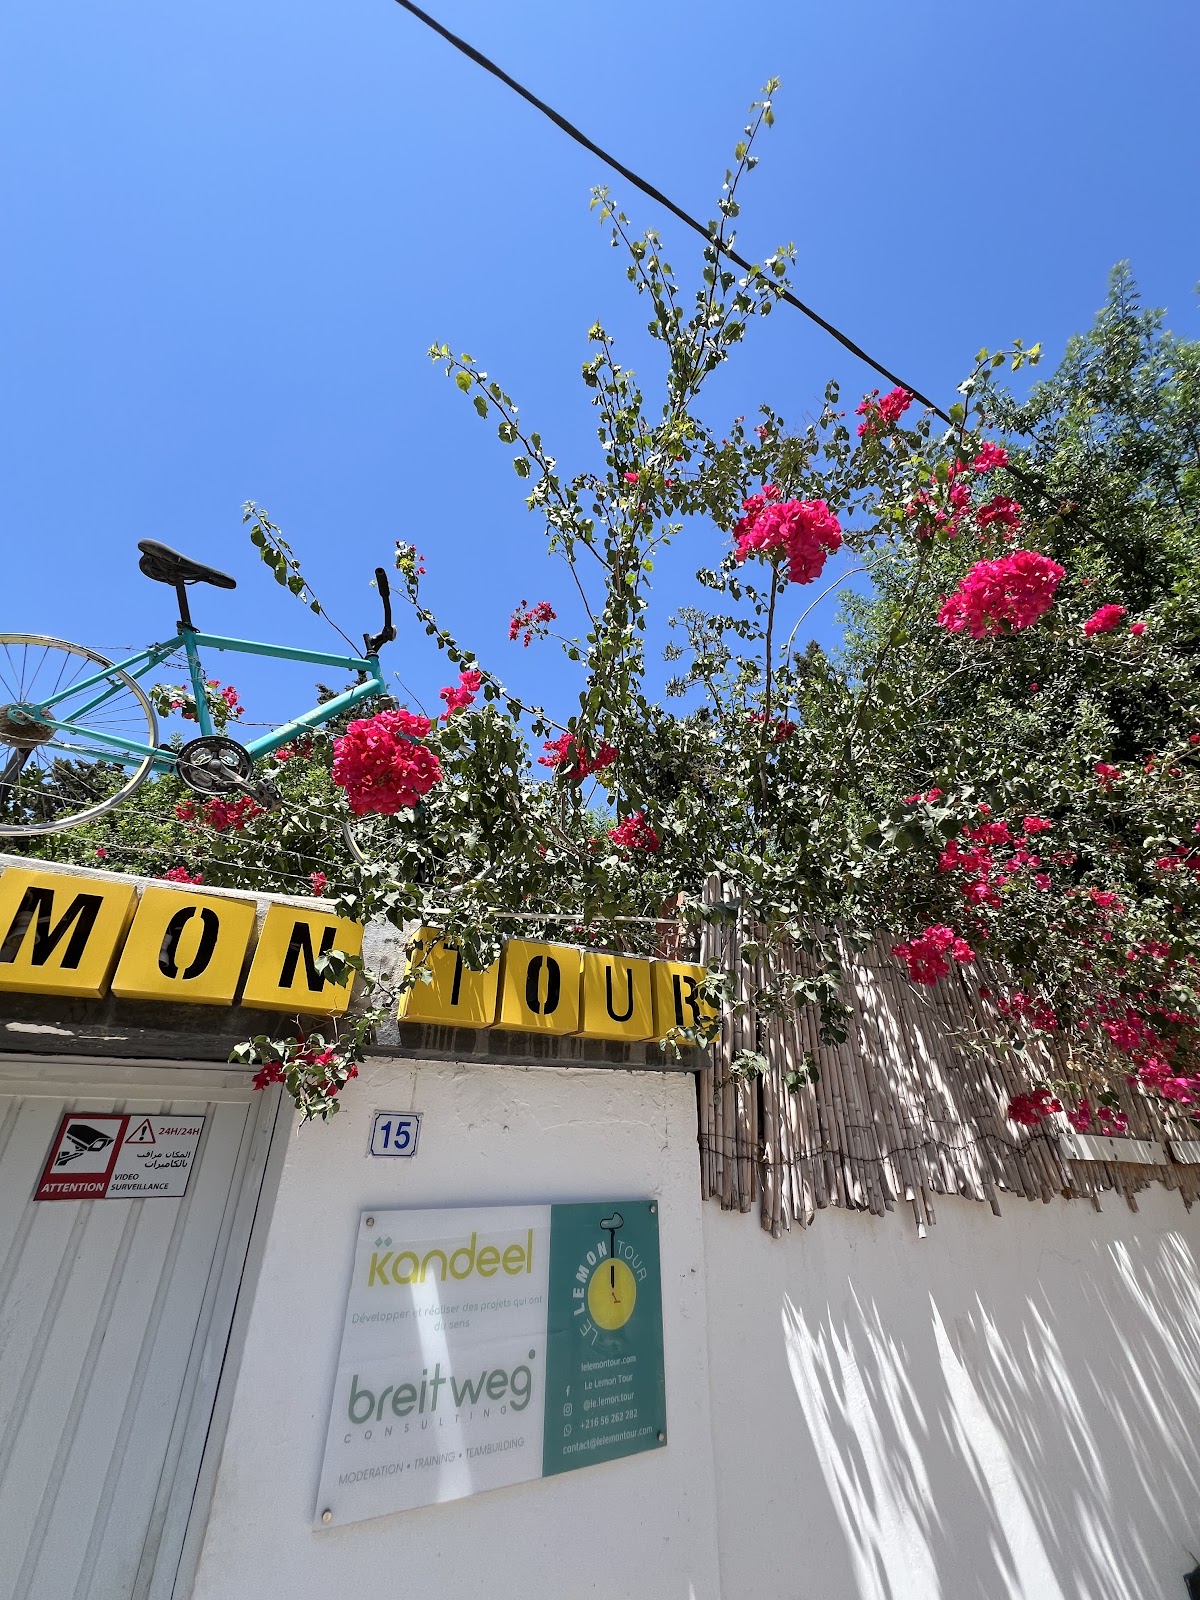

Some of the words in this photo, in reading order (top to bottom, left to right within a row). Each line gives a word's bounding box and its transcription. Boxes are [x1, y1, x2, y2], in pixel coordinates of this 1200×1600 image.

[443, 942, 702, 1027] TOUR
[158, 1127, 200, 1136] 24H/24H
[381, 1121, 411, 1149] 15
[144, 1159, 188, 1170] بالكاميرات
[165, 1150, 191, 1158] المكان
[41, 1183, 105, 1192] ATTENTION
[110, 1182, 169, 1191] SURVEILLANCE
[114, 1173, 139, 1181] VIDEO
[617, 1240, 647, 1282] TOUR
[572, 1241, 607, 1316] LEMON
[351, 1311, 410, 1324] Développer
[413, 1308, 422, 1318] et
[424, 1304, 461, 1317] réaliser
[462, 1301, 479, 1312] des
[481, 1298, 512, 1313] projets
[513, 1296, 527, 1308] qui
[528, 1295, 543, 1305] ont
[434, 1321, 446, 1332] du
[449, 1318, 471, 1329] sens
[580, 1318, 598, 1346] LE
[581, 1355, 637, 1372] lelemontour.com
[348, 1363, 532, 1424] breitweg
[584, 1381, 593, 1390] Le
[594, 1377, 617, 1388] Lemon
[618, 1373, 634, 1383] Tour
[344, 1405, 507, 1444] CONSULTING
[580, 1417, 599, 1430] +216
[600, 1415, 610, 1426] 56
[611, 1412, 624, 1423] 262
[625, 1408, 638, 1420] 282
[562, 1425, 653, 1455] contact@lelemontour.com
[338, 1461, 403, 1485] MODERATION
[414, 1451, 456, 1470] TRAINING
[465, 1436, 525, 1458] TEAMBUILDING
